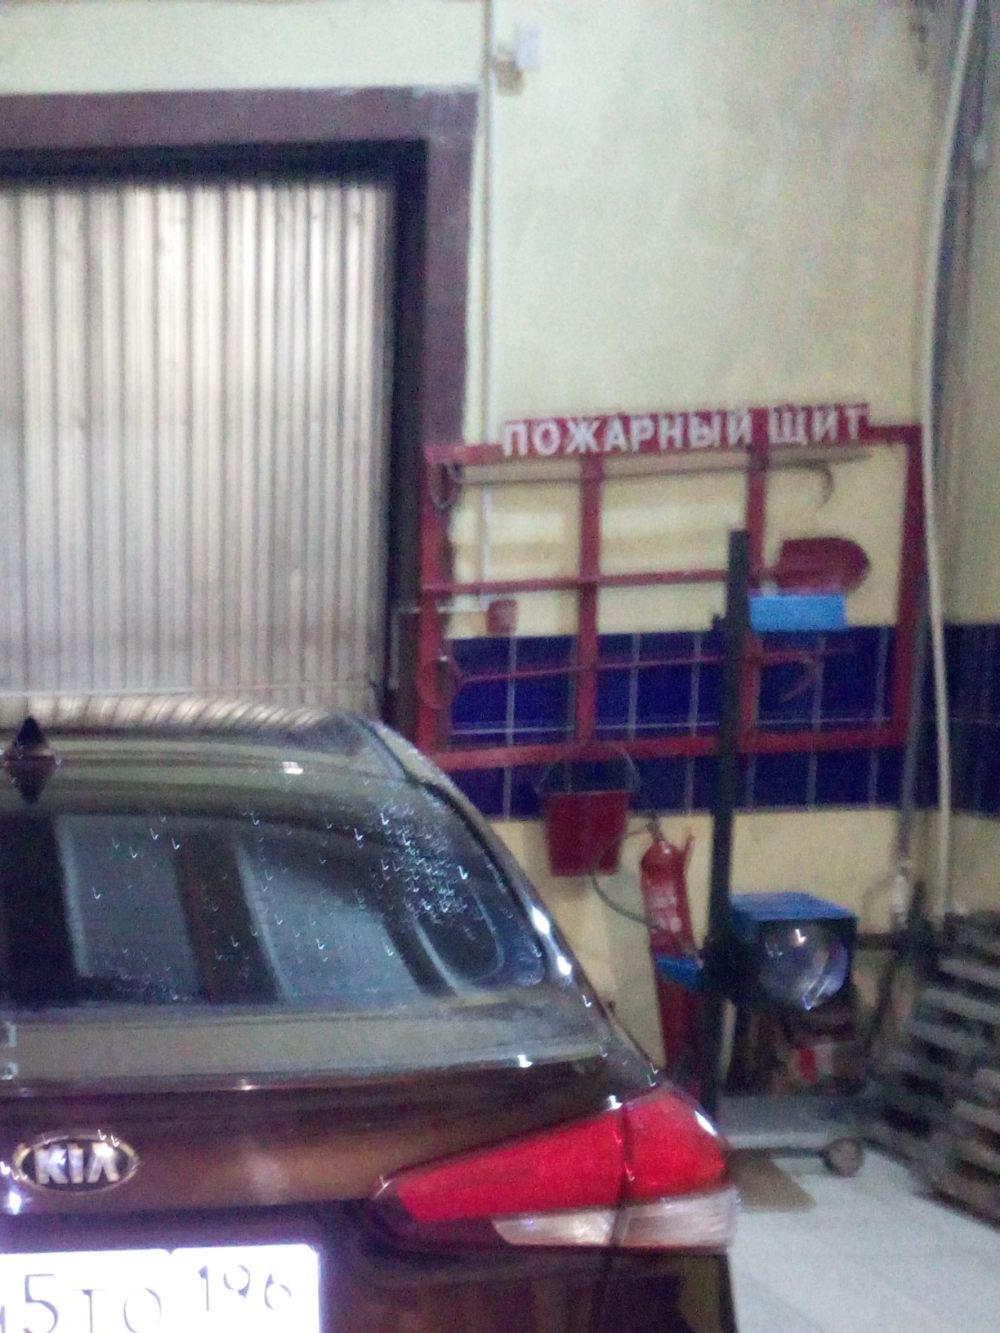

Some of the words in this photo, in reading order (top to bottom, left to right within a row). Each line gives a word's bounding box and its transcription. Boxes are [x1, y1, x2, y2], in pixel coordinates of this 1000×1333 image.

[502, 407, 750, 457] ПОЖАРНЫЙ
[767, 403, 867, 447] ЩИТ
[34, 1142, 121, 1185] KIA
